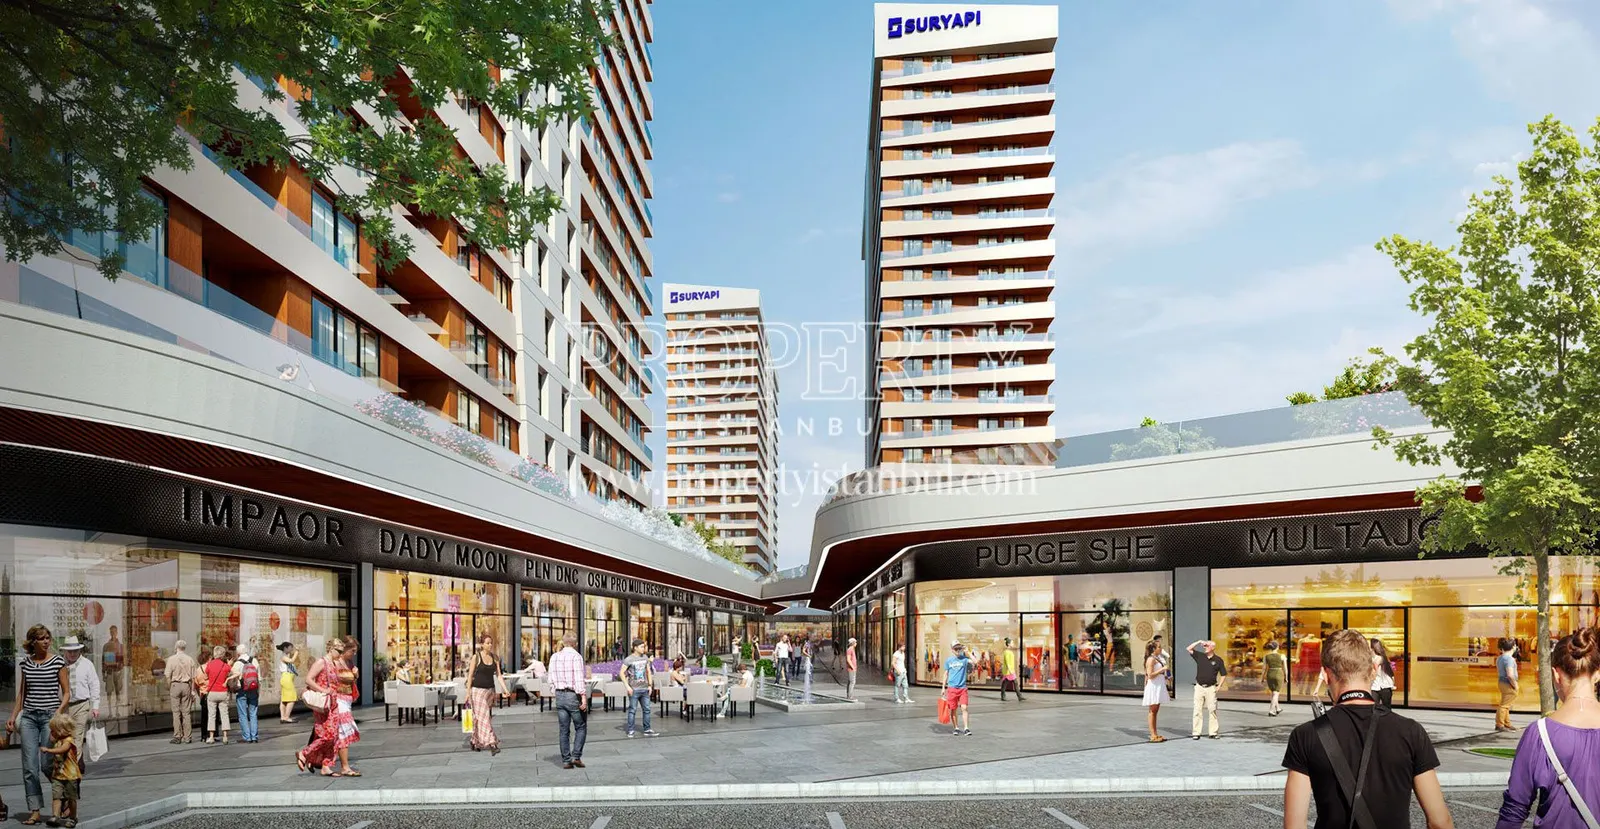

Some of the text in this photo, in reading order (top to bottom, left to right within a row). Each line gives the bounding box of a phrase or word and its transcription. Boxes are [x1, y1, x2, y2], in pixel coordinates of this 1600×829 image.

[904, 10, 981, 34] SURYAPI
[678, 290, 720, 302] SURYAPI
[181, 486, 345, 546] IMPAOR
[379, 528, 509, 573] DADY MOON
[975, 534, 1156, 569] PURGE SHE
[524, 558, 579, 585] PLN DNC
[587, 572, 627, 592] OSM PRO
